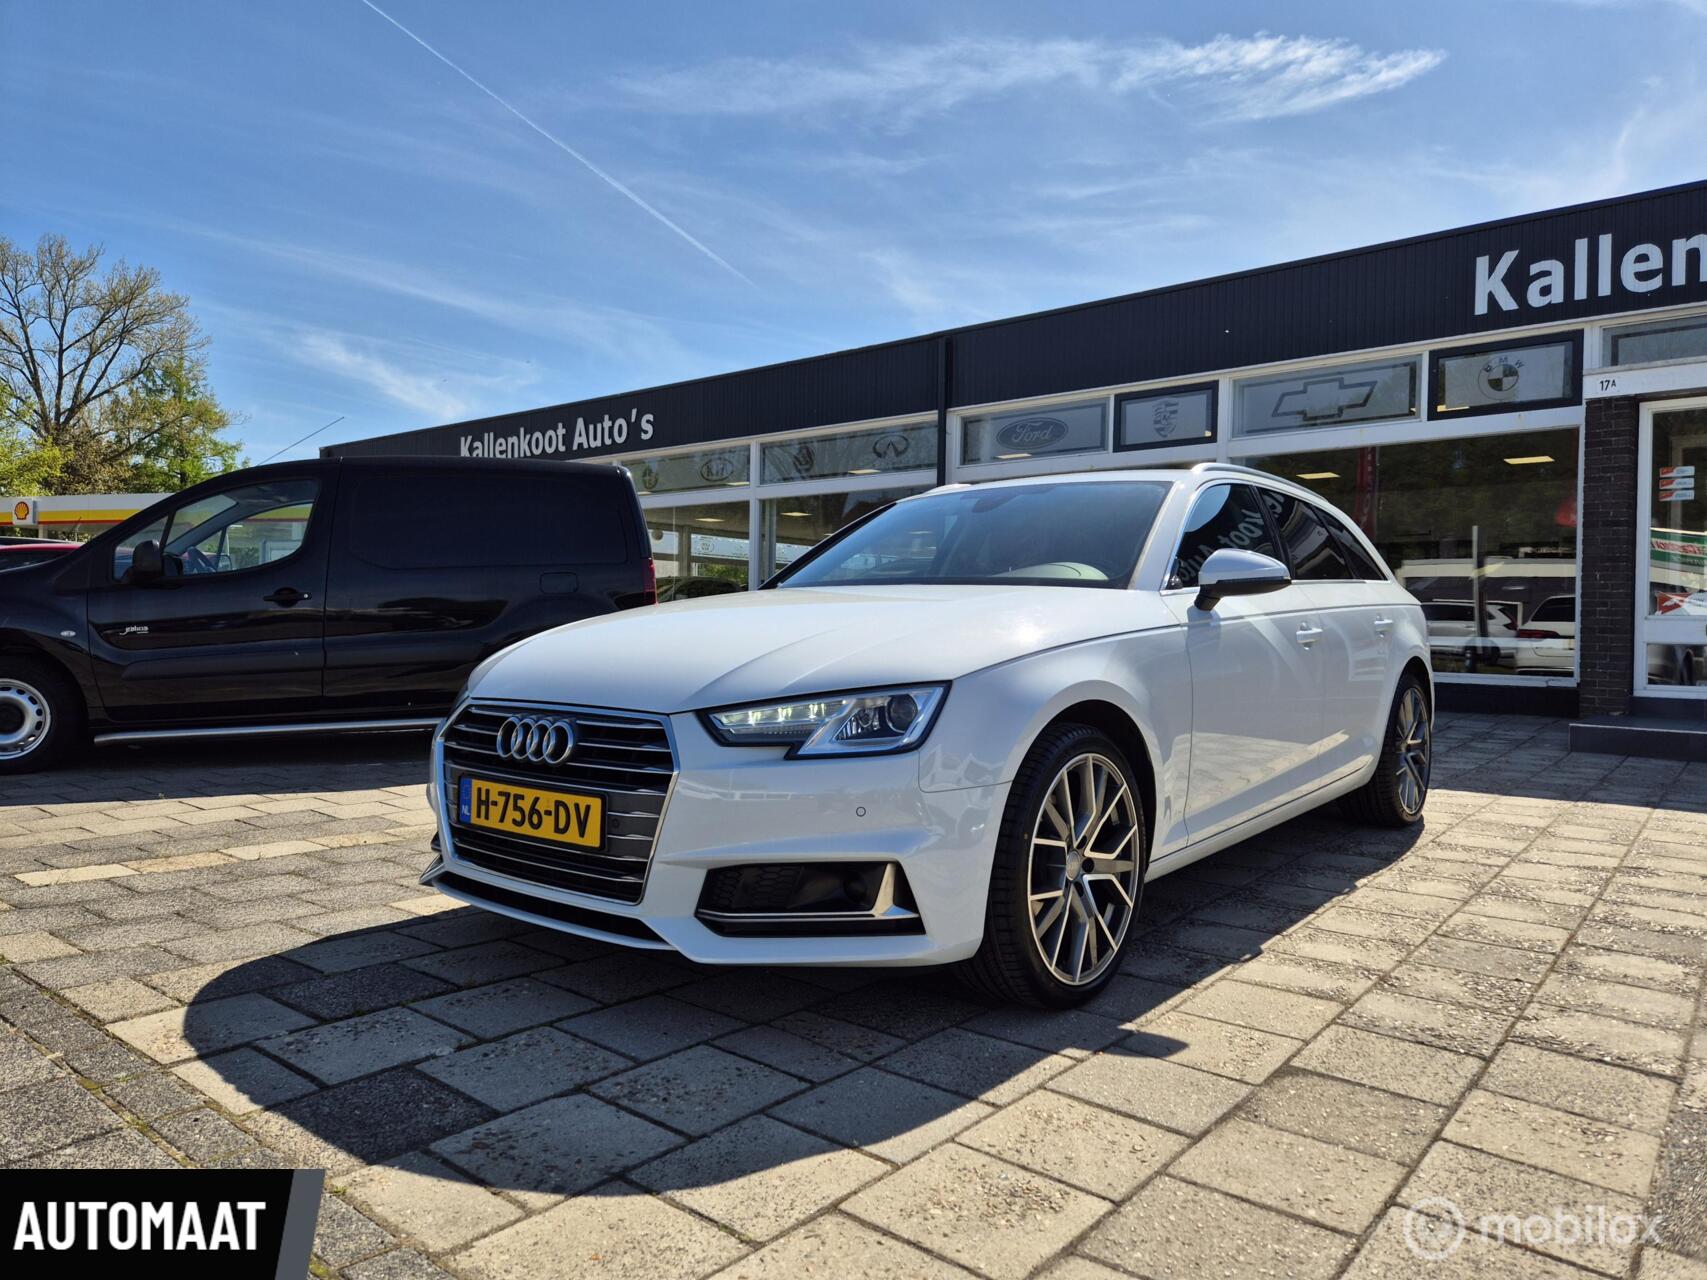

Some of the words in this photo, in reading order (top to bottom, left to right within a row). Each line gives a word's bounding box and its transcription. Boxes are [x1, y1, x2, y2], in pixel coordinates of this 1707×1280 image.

[1474, 233, 1707, 316] Kallen
[460, 422, 567, 458] Kallenkoot
[572, 408, 654, 450] Auto's
[1011, 421, 1054, 442] Ford
[460, 804, 471, 817] NL
[476, 786, 591, 839] H-756-DV
